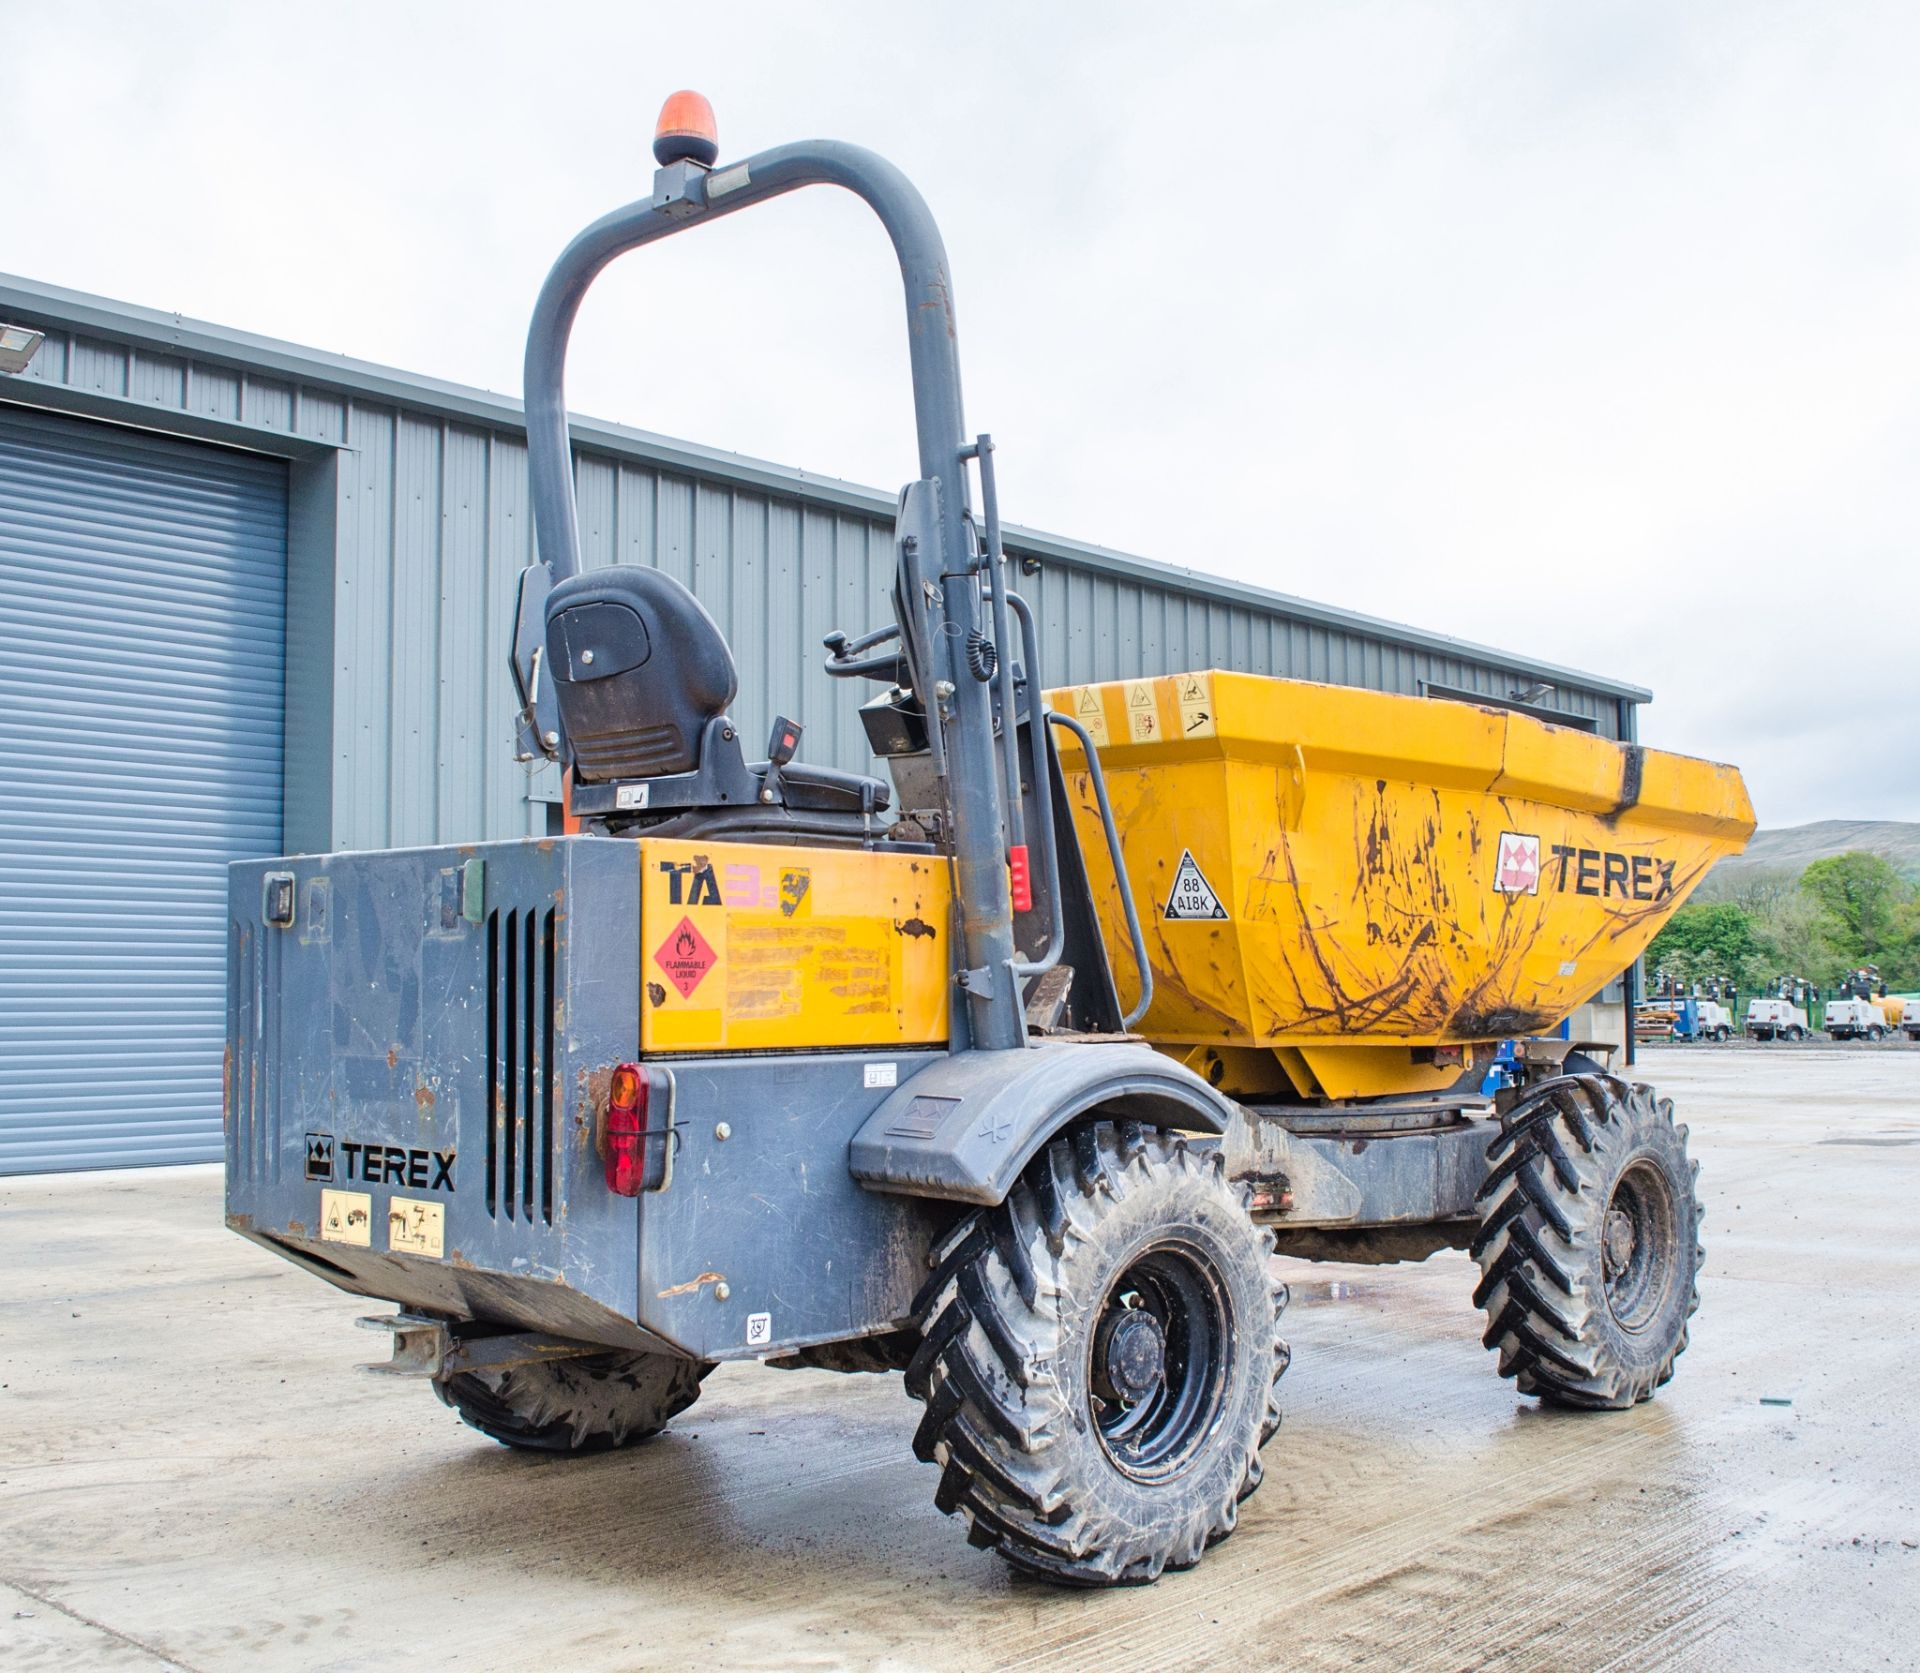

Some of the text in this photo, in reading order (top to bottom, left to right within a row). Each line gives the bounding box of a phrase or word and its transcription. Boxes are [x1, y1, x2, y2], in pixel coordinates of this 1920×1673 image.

[1551, 844, 1676, 901] TEREX
[1183, 878, 1200, 893] 88
[665, 960, 706, 970] FLAMMABLE
[675, 970, 697, 979] LIQUID
[683, 982, 689, 991] 3
[340, 1142, 457, 1192] TEREX
